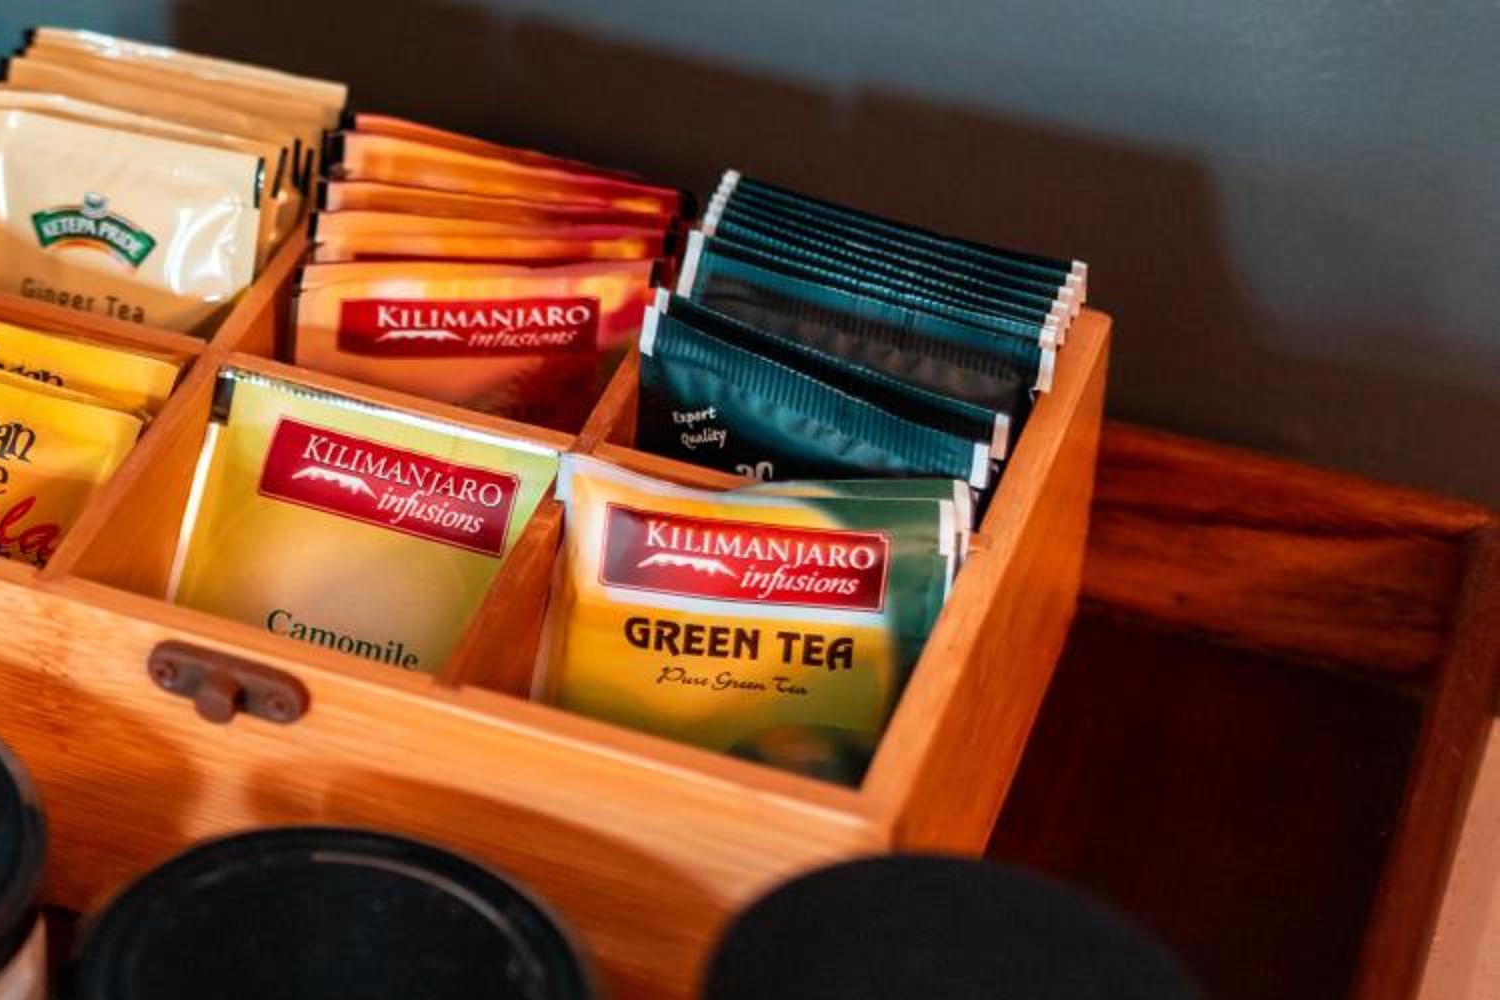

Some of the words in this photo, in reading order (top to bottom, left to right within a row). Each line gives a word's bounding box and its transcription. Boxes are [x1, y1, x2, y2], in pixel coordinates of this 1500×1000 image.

[21, 277, 95, 309] Ginger
[106, 295, 145, 323] Tea
[377, 305, 591, 334] KILIMANJARO
[468, 329, 579, 349] infusions
[680, 427, 727, 449] Quality
[303, 434, 503, 508] KILIMANJARO
[376, 487, 485, 534] infusions
[646, 521, 876, 571] KILIMANJARO
[739, 564, 859, 599] infusions
[266, 608, 420, 670] Camomile
[624, 616, 761, 661] GREEN
[777, 631, 854, 672] TEA
[656, 667, 708, 687] Pure
[711, 671, 766, 691] Green
[772, 675, 808, 695] Tea
